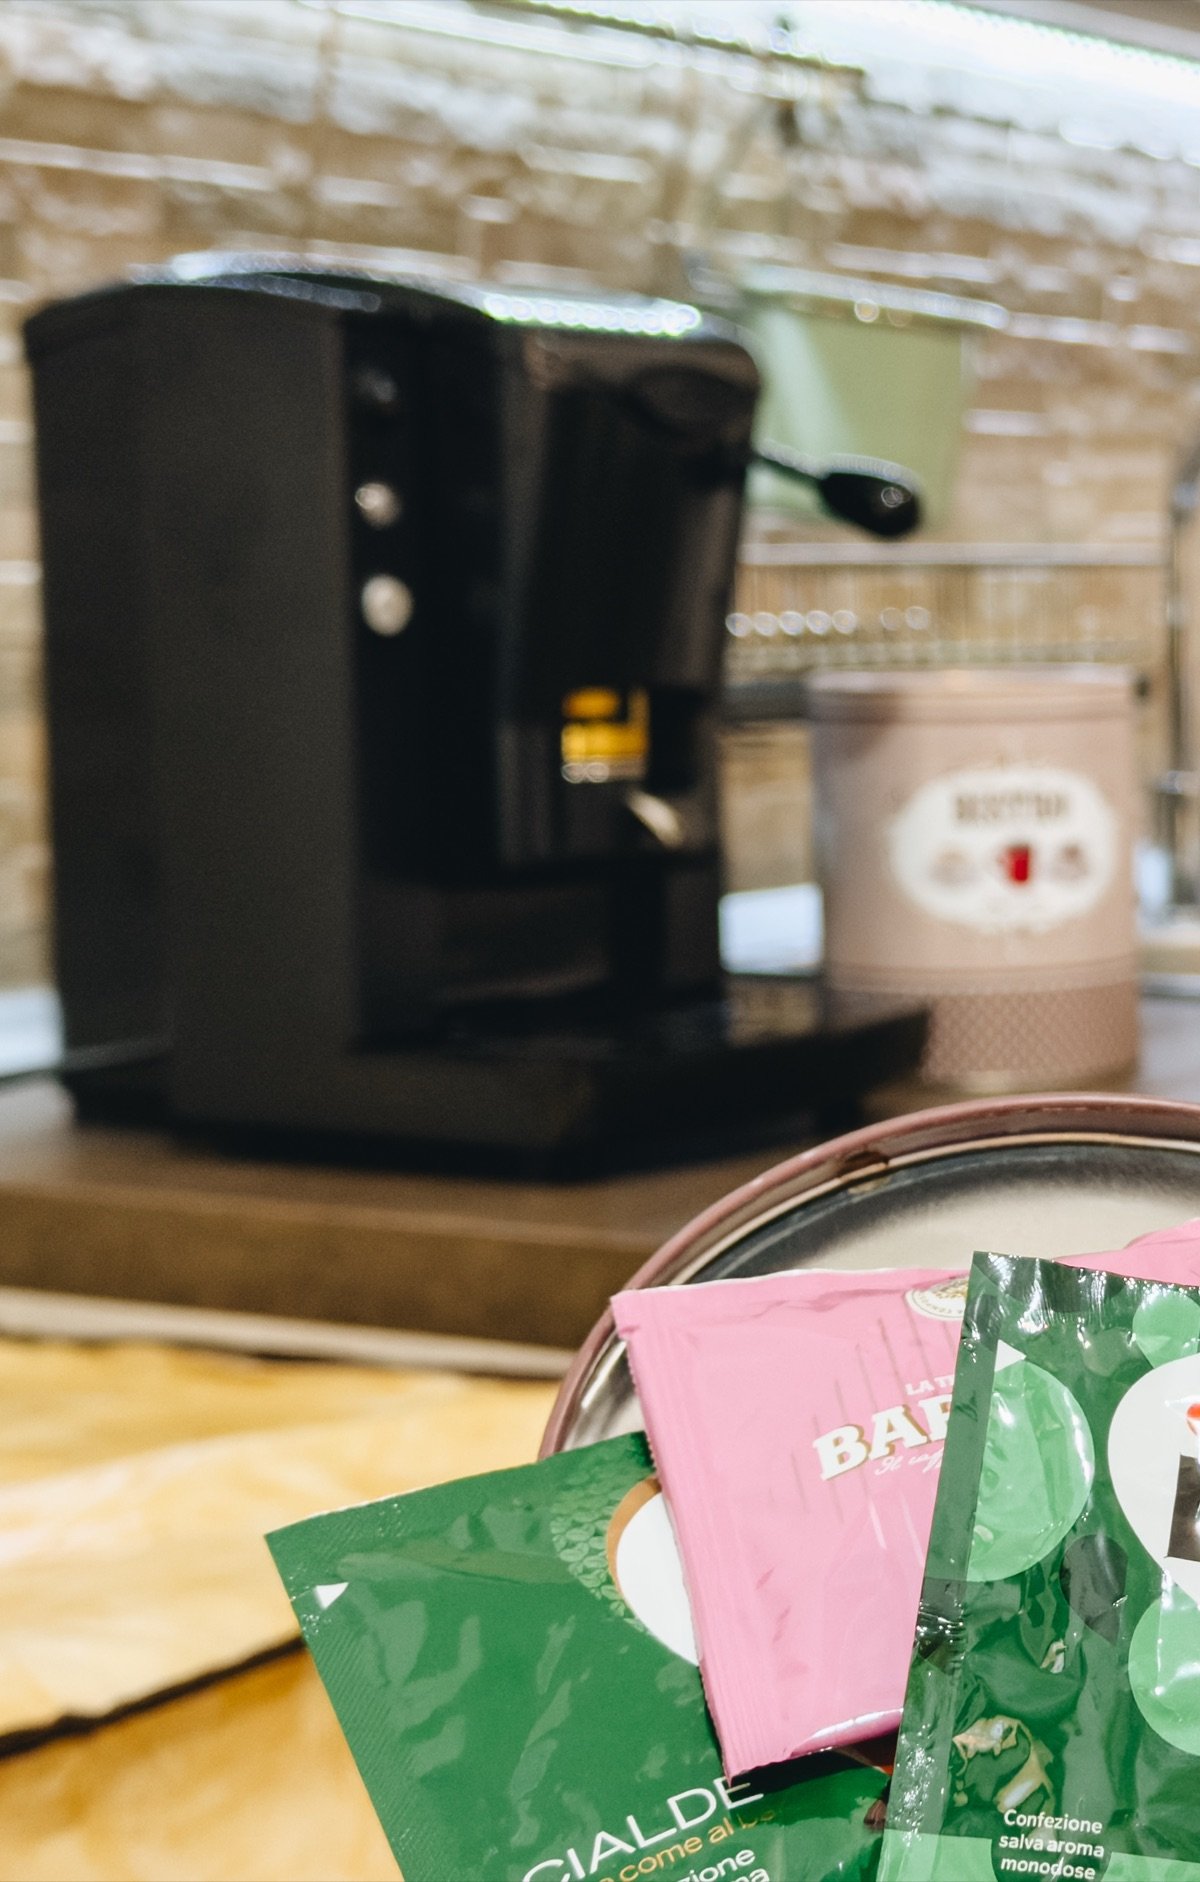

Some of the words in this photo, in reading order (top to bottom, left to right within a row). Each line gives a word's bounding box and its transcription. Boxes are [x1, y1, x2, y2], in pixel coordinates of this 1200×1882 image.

[522, 1775, 764, 1882] CIALDE
[1003, 1808, 1103, 1834] Confezione
[619, 1836, 704, 1882] come
[708, 1816, 735, 1843] al
[998, 1833, 1044, 1851] salva
[1046, 1838, 1105, 1857] aroma
[1000, 1856, 1096, 1880] monodose
